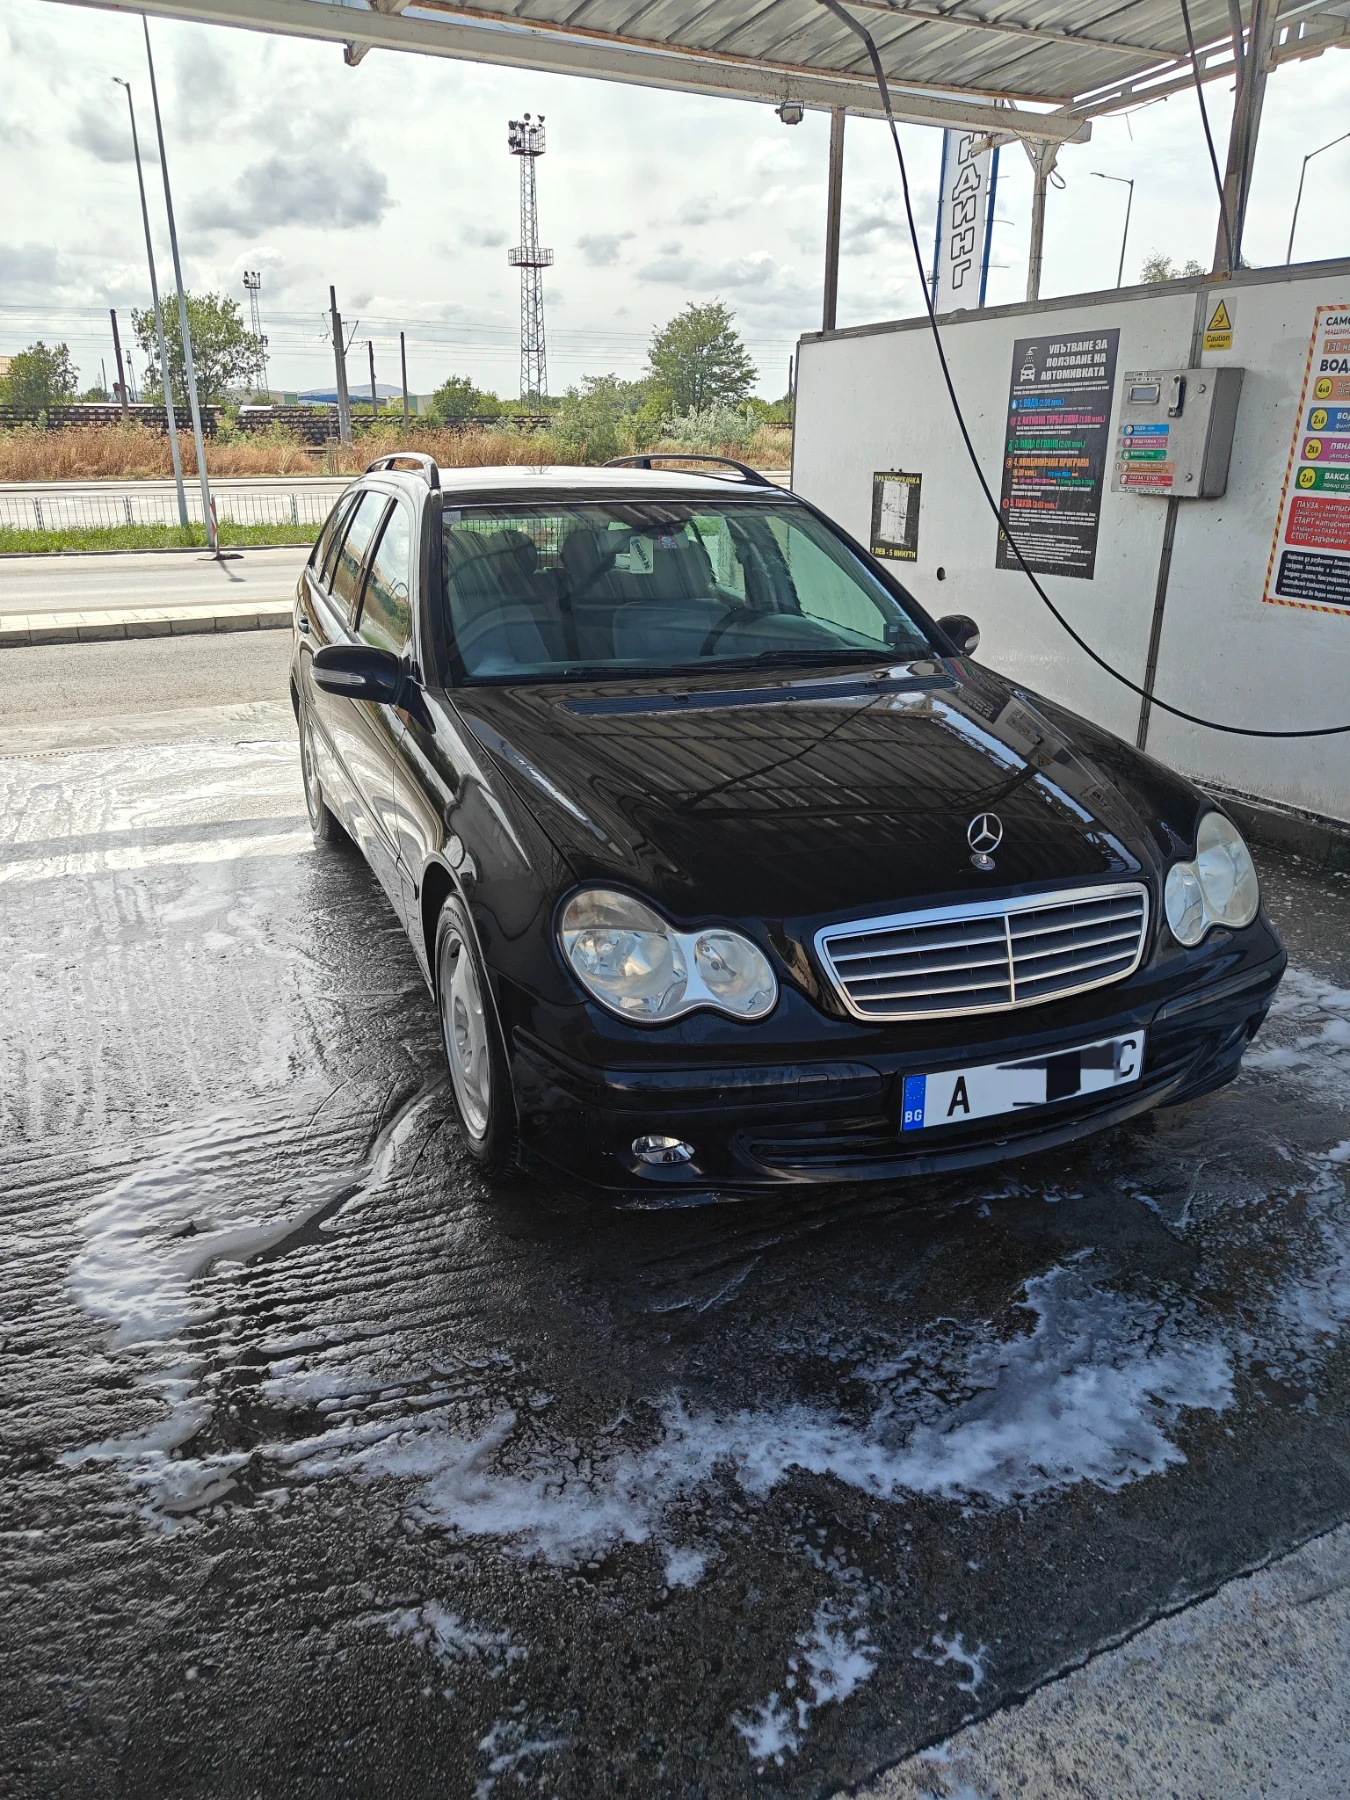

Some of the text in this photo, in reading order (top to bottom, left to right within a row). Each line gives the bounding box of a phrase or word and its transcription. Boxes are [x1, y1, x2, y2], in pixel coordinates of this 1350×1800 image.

[1049, 339, 1108, 354] УПЪТВАНЕ ЗА
[1046, 353, 1106, 368] ПОЛЗВАНЕ НА
[1320, 359, 1350, 373] ВОД
[1040, 366, 1105, 380] АВТОМИВКАТА
[1297, 501, 1318, 509] ПАУЗА
[1294, 517, 1315, 525] СТАРТ
[635, 543, 650, 570] mobile.bg
[893, 550, 916, 558] МИНУТИ
[947, 1076, 970, 1116] A
[904, 1109, 922, 1123] BG
